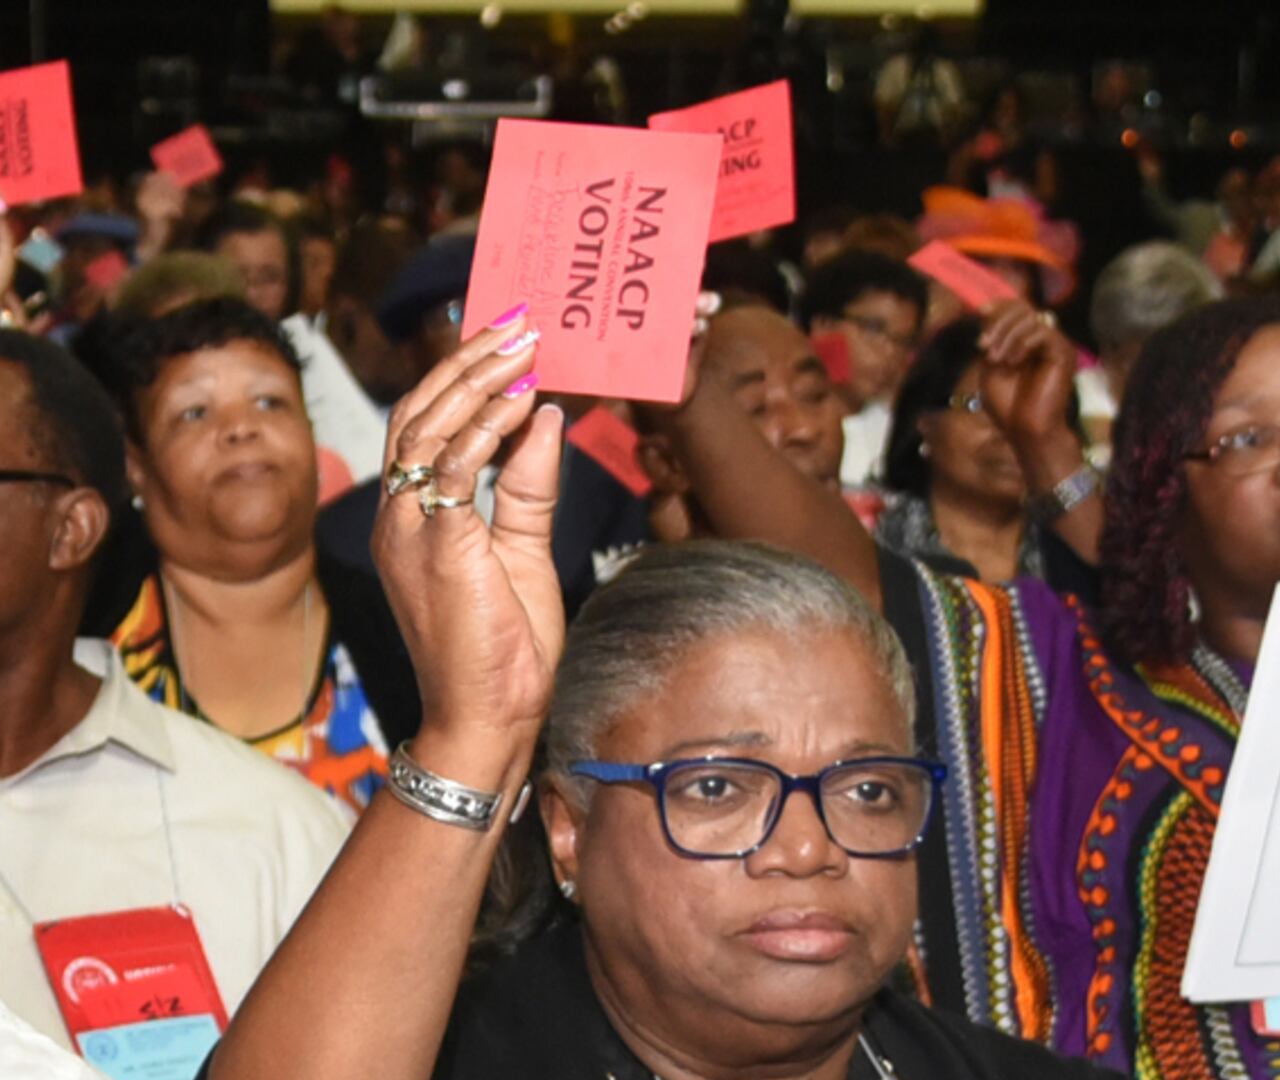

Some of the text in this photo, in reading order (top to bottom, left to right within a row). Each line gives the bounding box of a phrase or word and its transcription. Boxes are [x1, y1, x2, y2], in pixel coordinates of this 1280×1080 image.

[717, 117, 756, 144] ACP
[719, 149, 762, 178] ING
[560, 177, 616, 331] VOTING
[617, 186, 668, 332] NAACP
[598, 261, 619, 342] CONVENTION
